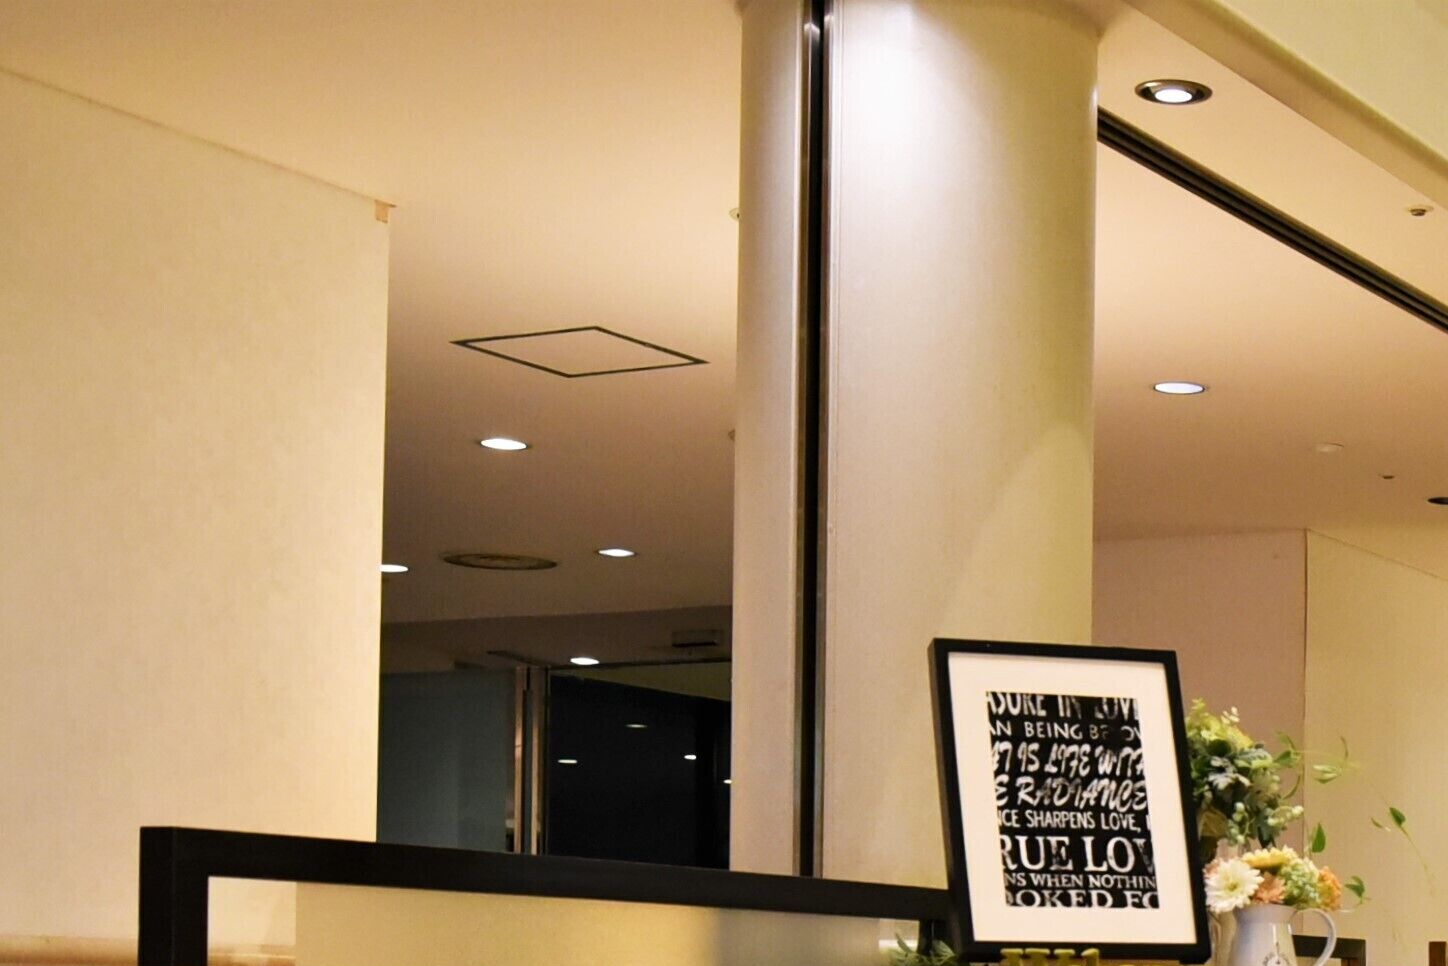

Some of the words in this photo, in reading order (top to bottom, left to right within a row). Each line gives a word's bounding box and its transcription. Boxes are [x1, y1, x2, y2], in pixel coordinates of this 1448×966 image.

[1057, 694, 1083, 719] IN
[1024, 721, 1083, 739] BEING
[1017, 741, 1040, 773] IS
[1044, 742, 1092, 778] LIFE
[1015, 775, 1148, 812] RADIANCE
[1025, 809, 1096, 830] SHARPENS
[1100, 812, 1142, 833] LOVE,
[999, 834, 1073, 870] RUE
[1029, 873, 1083, 888] WHEN
[1088, 874, 1157, 889] NOTHIN
